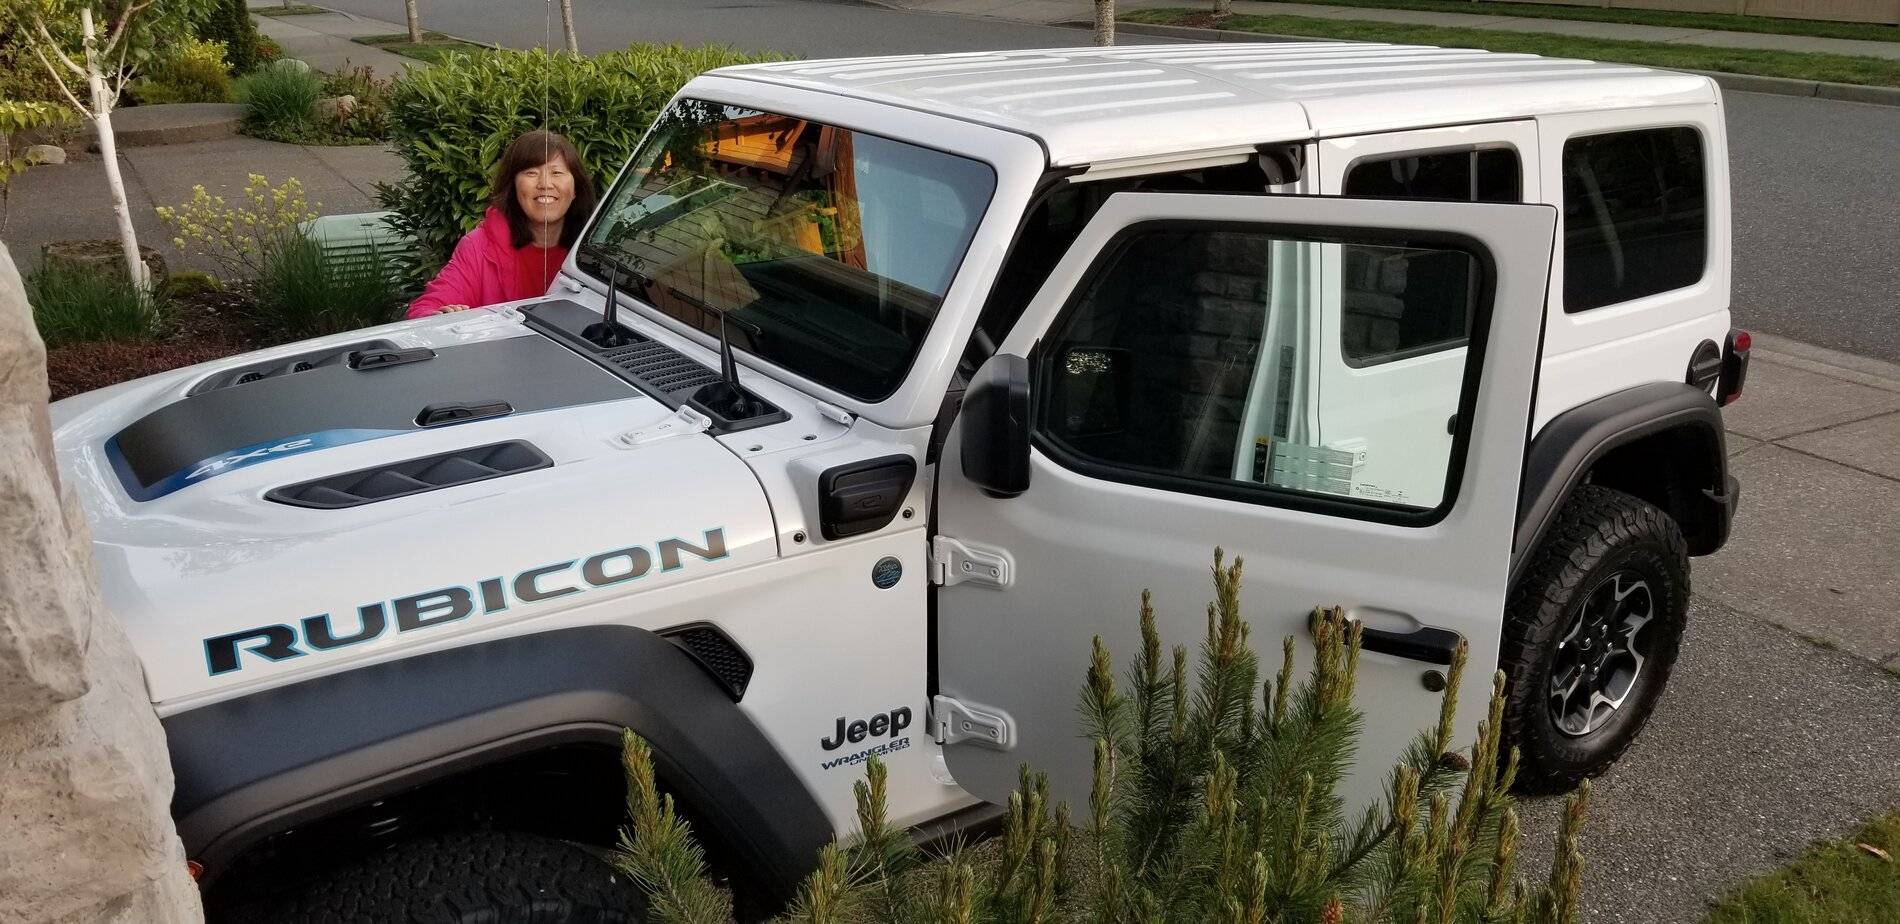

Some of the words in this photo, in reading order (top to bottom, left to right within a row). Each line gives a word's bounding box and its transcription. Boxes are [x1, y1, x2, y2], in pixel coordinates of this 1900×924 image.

[202, 526, 730, 677] RUBICON
[820, 706, 912, 751] Jeep
[820, 737, 910, 770] WRANGLER
[849, 743, 911, 766] UNMITED
